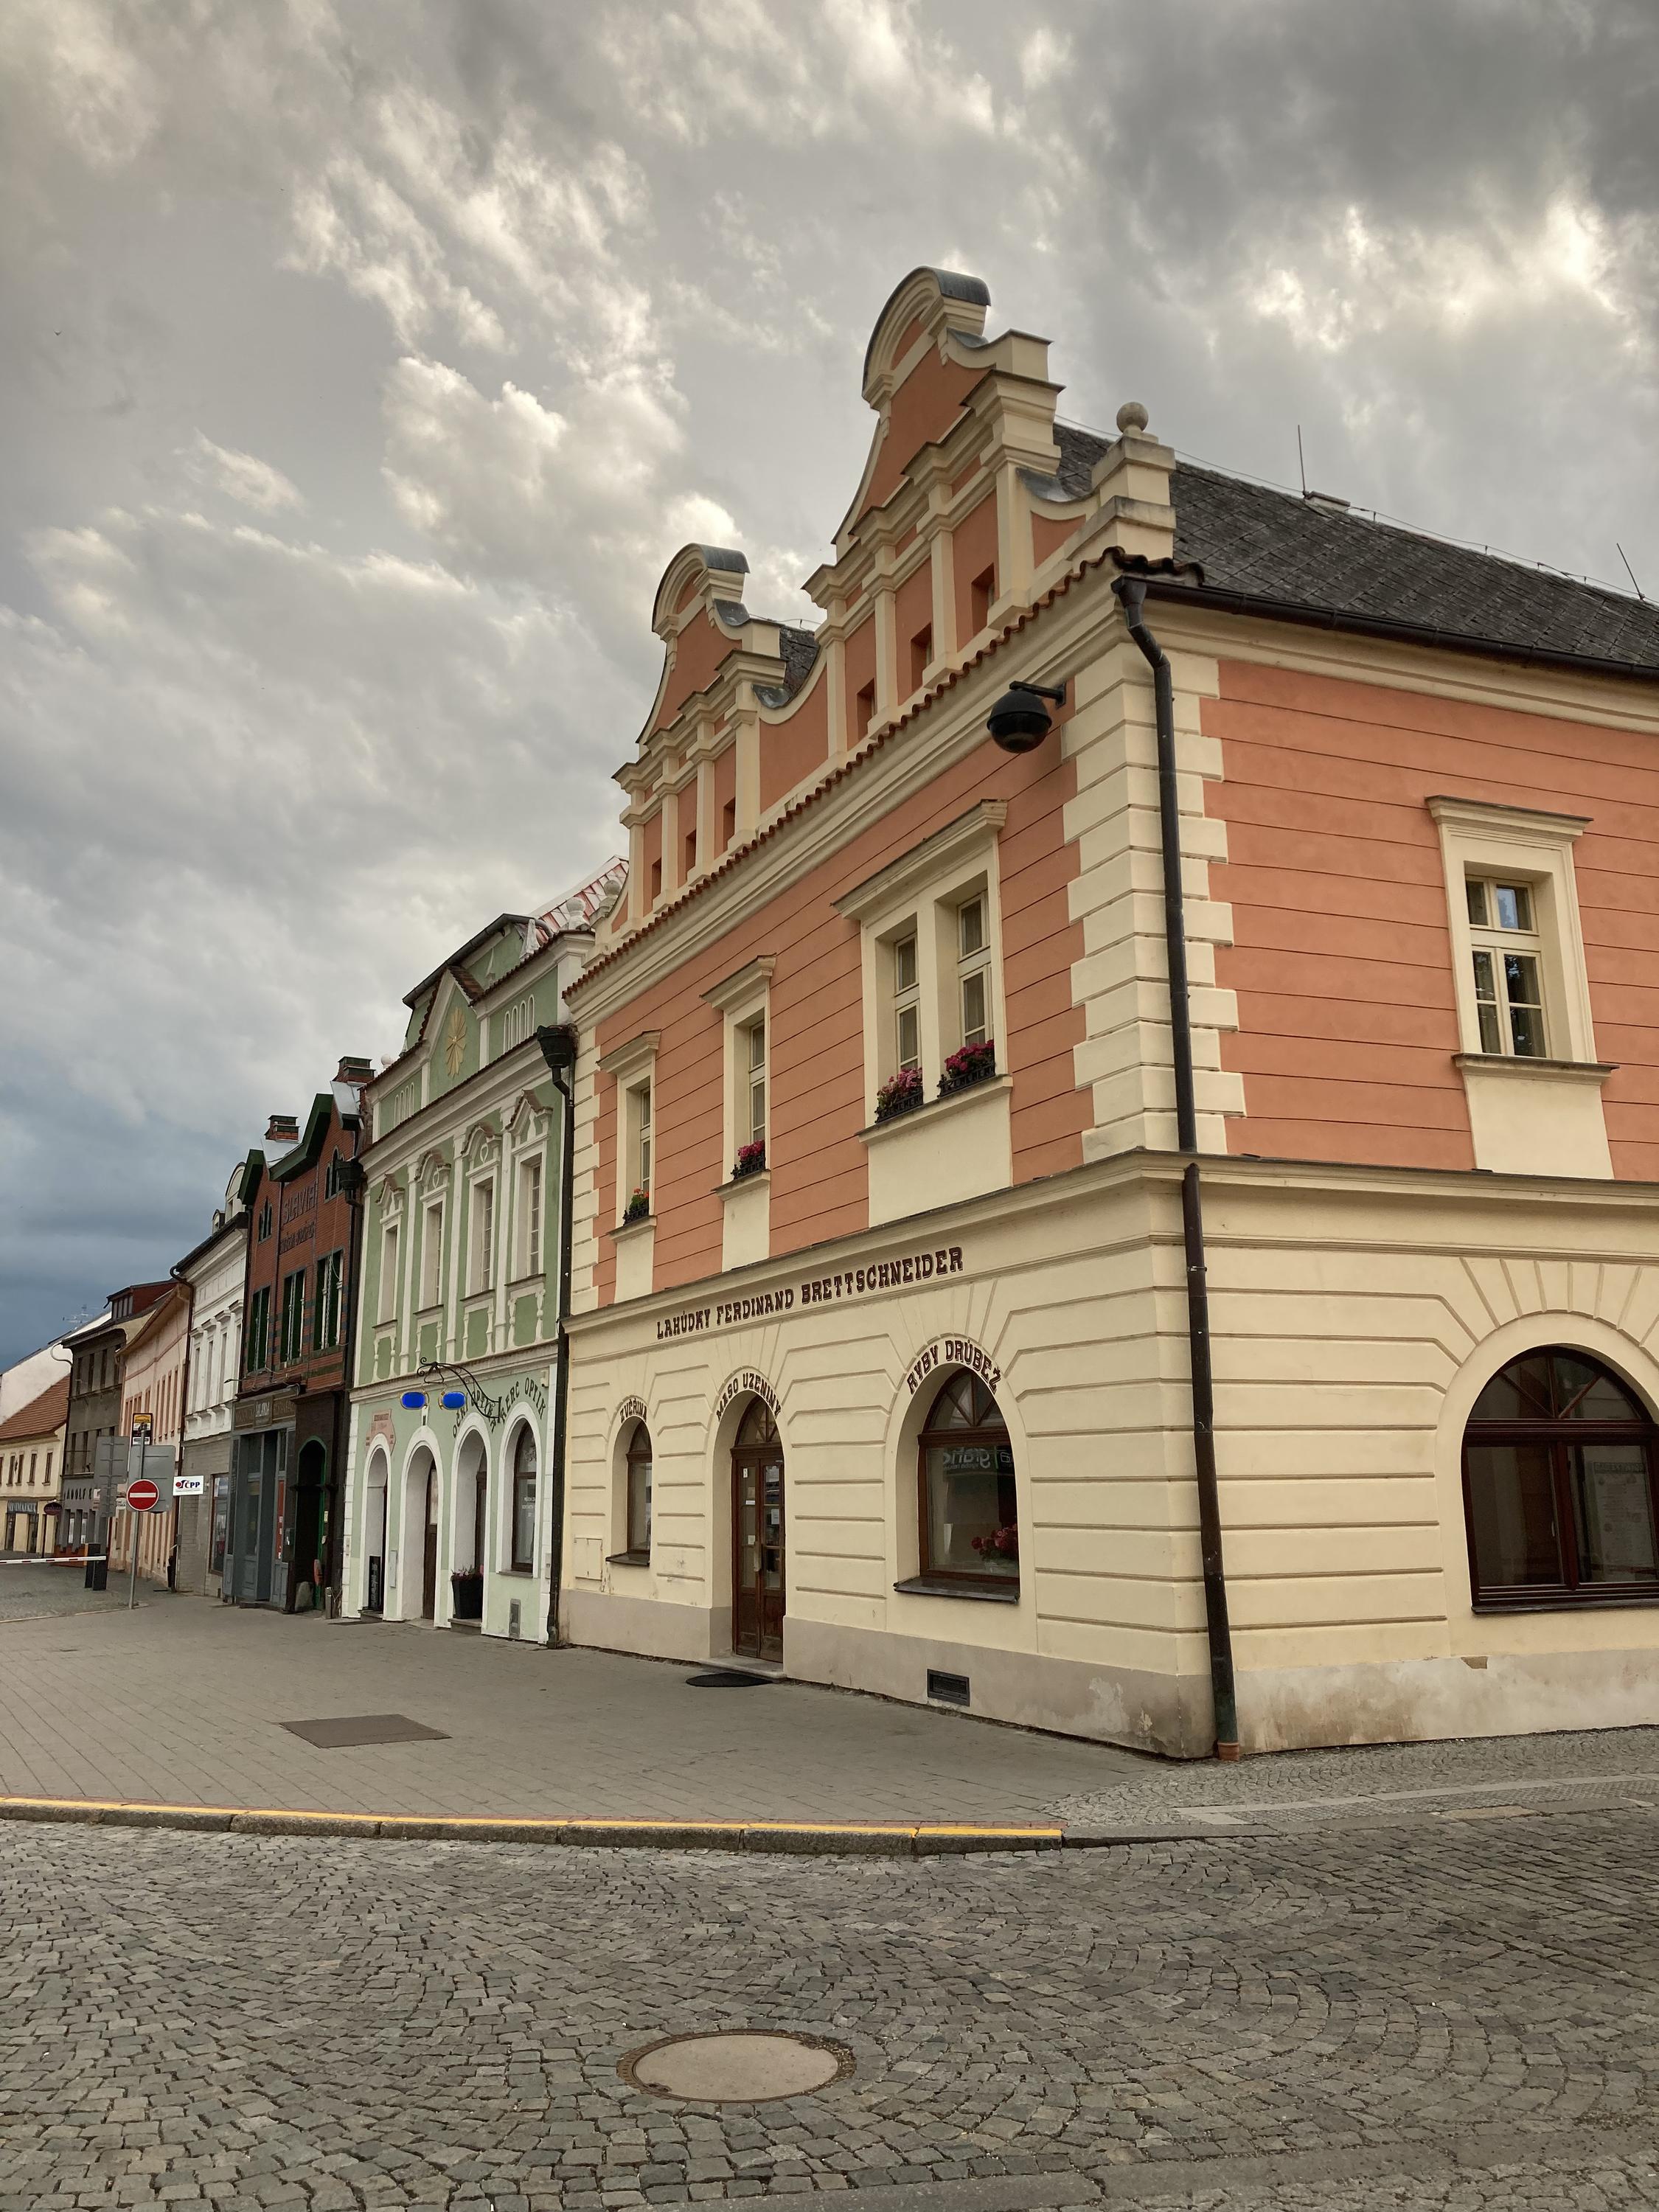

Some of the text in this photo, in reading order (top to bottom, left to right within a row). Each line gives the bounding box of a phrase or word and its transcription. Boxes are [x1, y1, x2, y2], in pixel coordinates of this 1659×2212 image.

[717, 1289, 794, 1326] FERDINAND
[801, 1247, 964, 1304] BRETTSCHNEIDER
[906, 1345, 938, 1395] RYBY
[620, 1397, 647, 1424] ZVĚŘINA
[716, 1372, 782, 1422] MASO UZENINY
